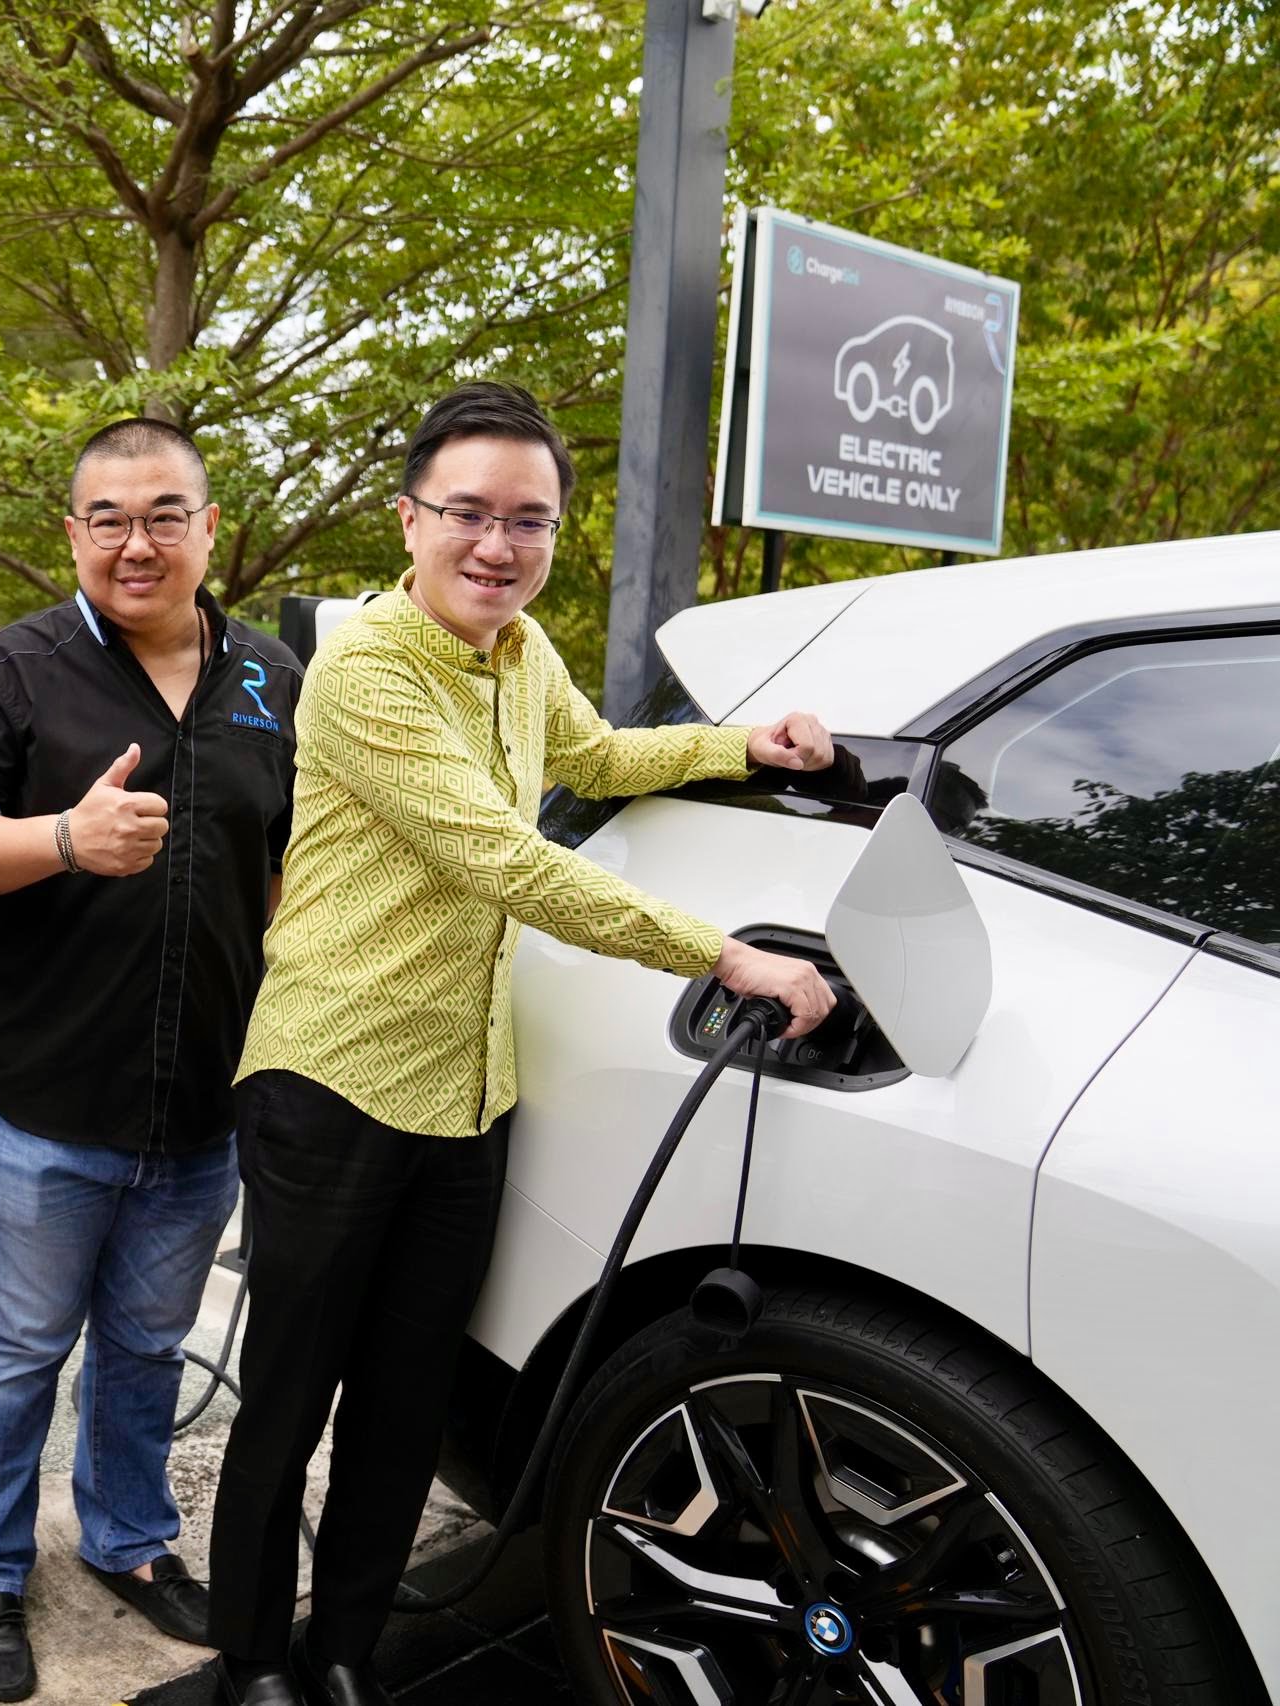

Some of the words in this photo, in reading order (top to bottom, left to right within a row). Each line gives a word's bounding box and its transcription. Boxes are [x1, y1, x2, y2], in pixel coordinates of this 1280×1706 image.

[839, 433, 942, 477] ELECTRIC
[807, 464, 902, 505] VEHICLE
[905, 481, 961, 513] ONLY
[232, 712, 279, 731] RIVERSON
